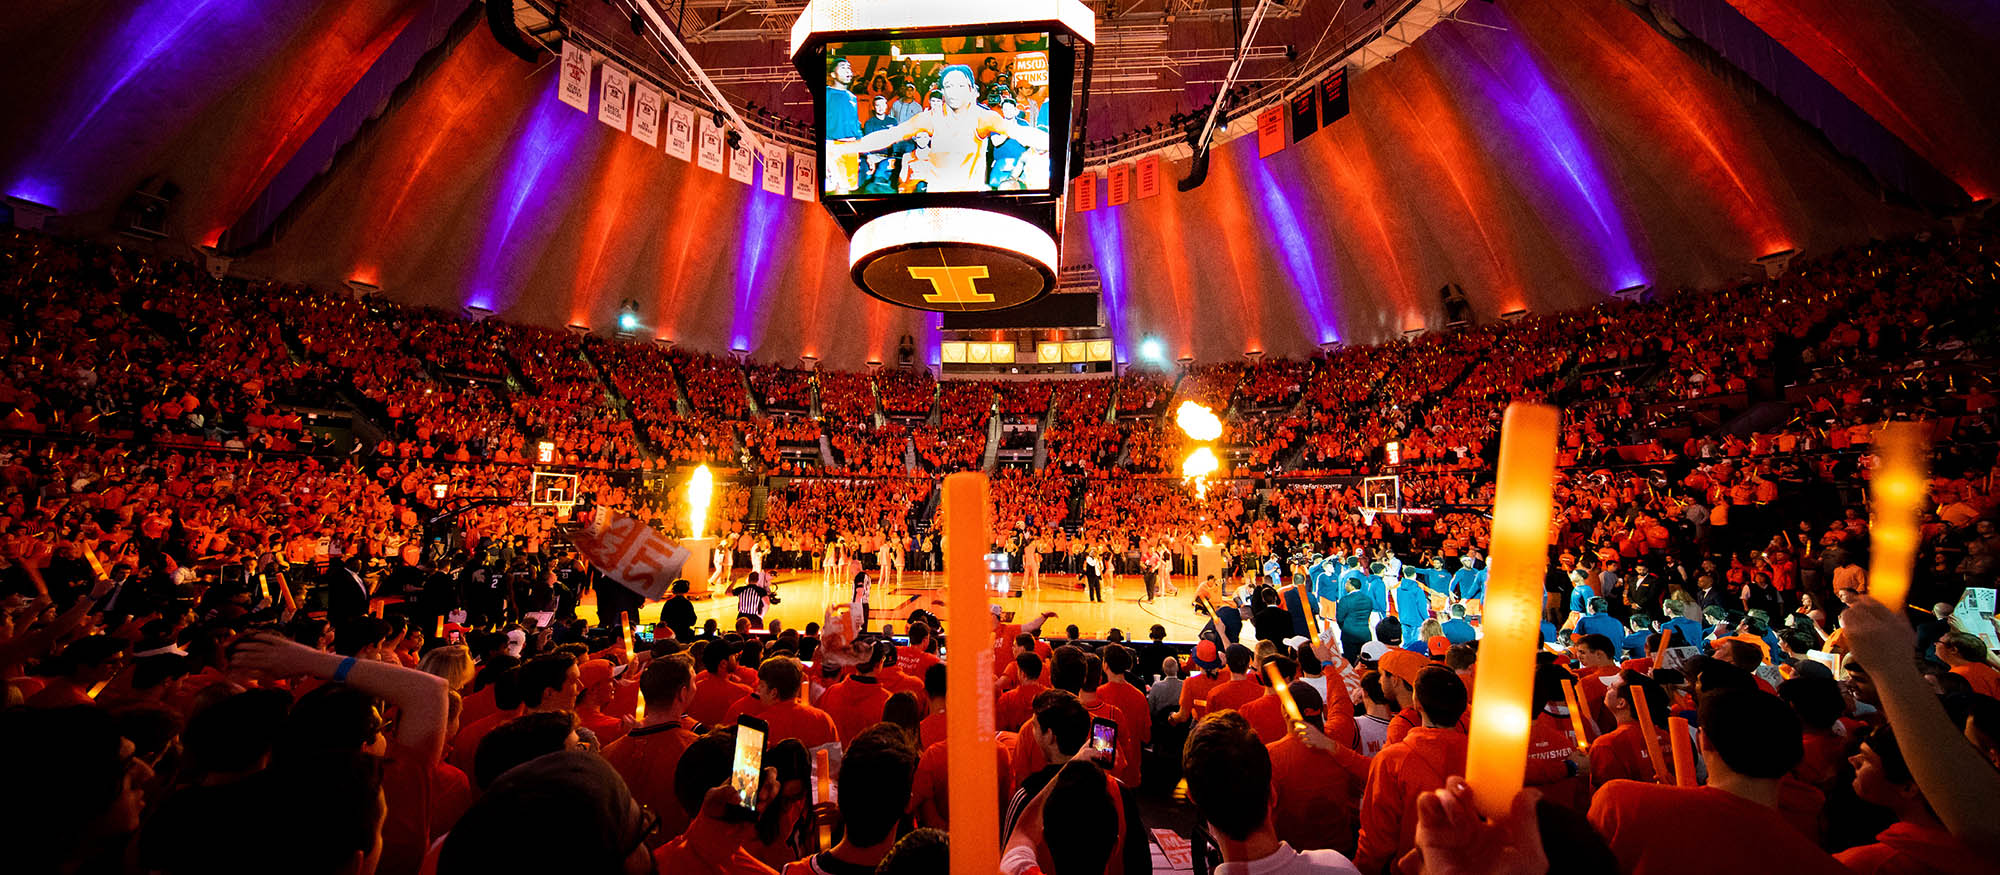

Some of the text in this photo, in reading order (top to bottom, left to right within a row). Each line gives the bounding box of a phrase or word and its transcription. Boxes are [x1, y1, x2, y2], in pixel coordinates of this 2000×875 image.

[1017, 59, 1045, 70] MS(U)
[1016, 72, 1047, 82] STINKS
[907, 265, 996, 303] I
[540, 451, 552, 462] 30
[491, 578, 498, 588] 2
